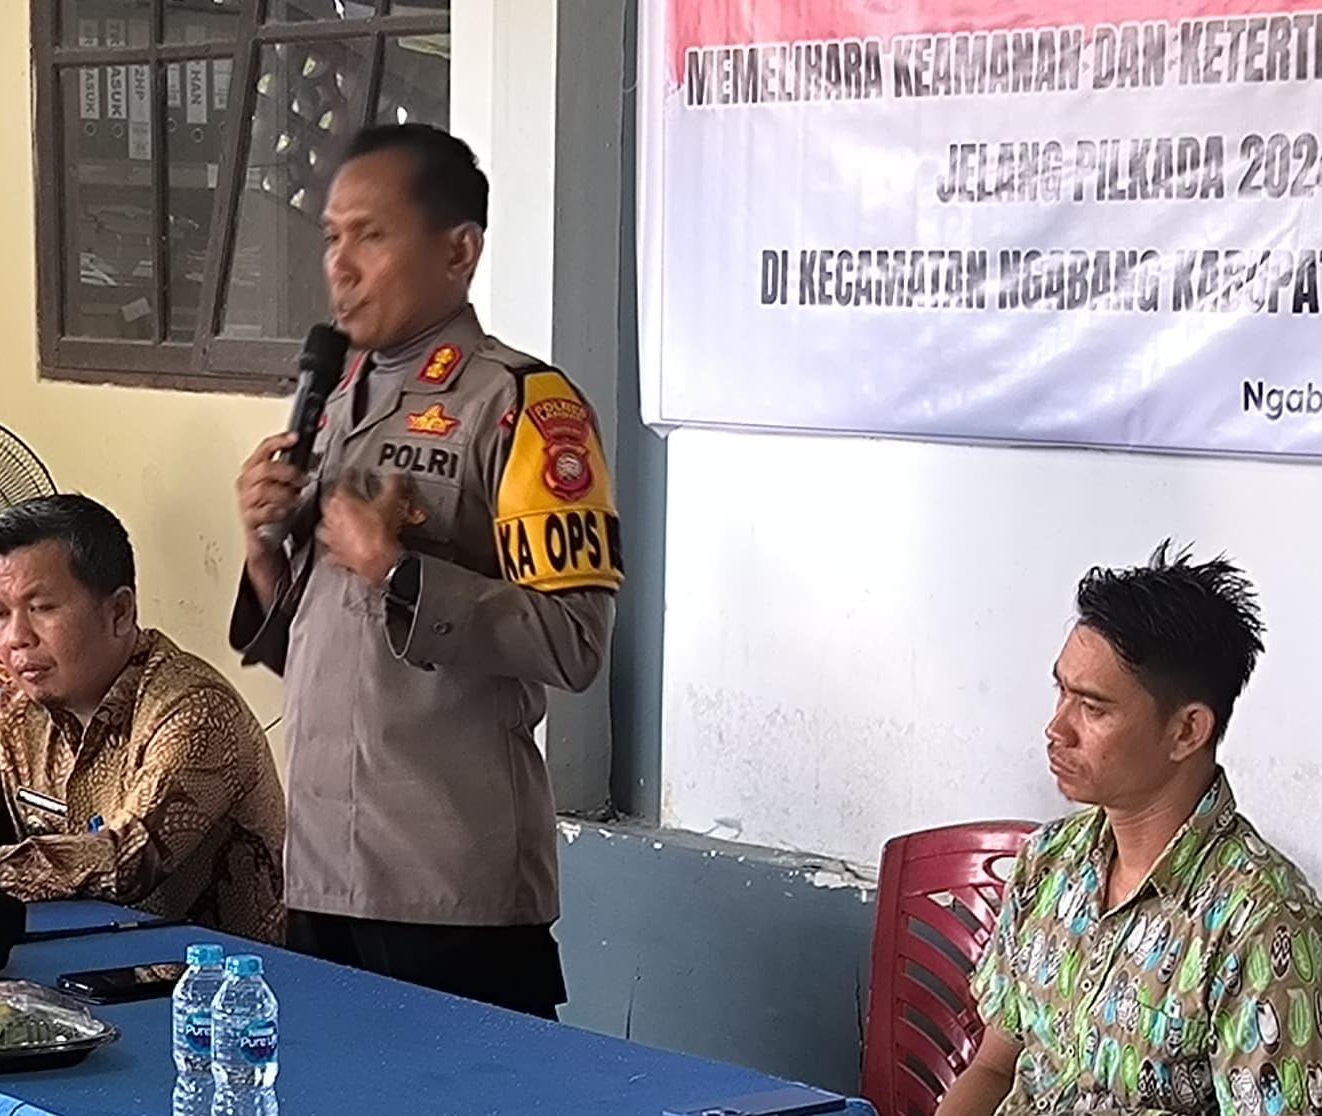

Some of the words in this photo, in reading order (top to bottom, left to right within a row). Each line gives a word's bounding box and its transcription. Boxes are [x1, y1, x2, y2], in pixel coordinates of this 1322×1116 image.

[686, 40, 883, 106] MEMELIHARA
[892, 29, 1082, 98] KEAMANAN
[1091, 22, 1167, 89] DAN
[936, 140, 1063, 200] JELANG
[1074, 136, 1225, 200] PILKADA
[761, 249, 789, 306] DI
[798, 249, 987, 309] KECAMATAN
[998, 250, 1159, 312] NGABANG
[378, 443, 458, 478] POLRI
[499, 519, 536, 582] KA
[545, 510, 602, 573] OPS
